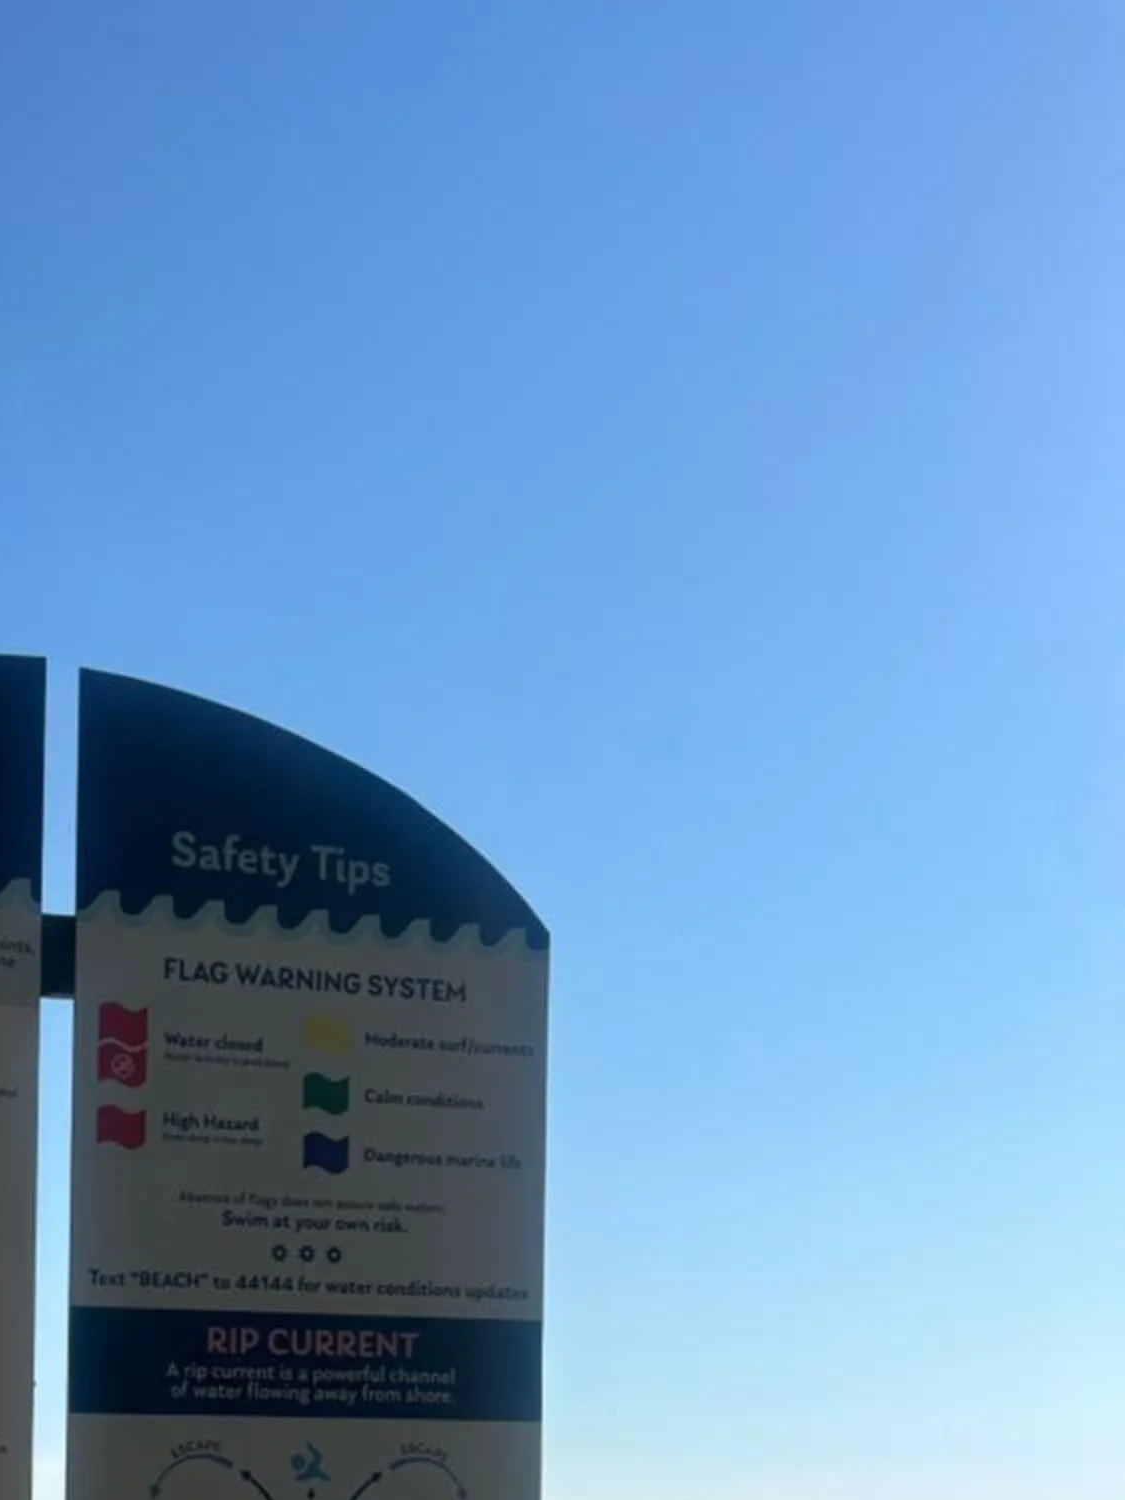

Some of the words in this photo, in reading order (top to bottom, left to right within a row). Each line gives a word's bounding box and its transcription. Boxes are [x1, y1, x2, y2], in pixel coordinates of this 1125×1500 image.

[171, 831, 300, 888] Safety
[310, 844, 391, 895] Tips
[163, 956, 228, 984] FLAG
[235, 962, 361, 995] WARNING
[368, 975, 467, 1002] SYSTEM
[164, 1032, 209, 1048] Water
[215, 1035, 263, 1052] closed
[365, 1032, 434, 1051] Moderate
[364, 1089, 403, 1105] Calm
[407, 1094, 484, 1109] conditions
[163, 1112, 200, 1131] High
[204, 1115, 259, 1131] Hazard
[364, 1148, 442, 1166] Dangerous
[446, 1156, 495, 1168] marine
[222, 1210, 268, 1227] Swim
[273, 1217, 290, 1229] at
[295, 1218, 332, 1233] your
[336, 1220, 369, 1231] own
[374, 1218, 408, 1233] risk.
[88, 1269, 125, 1286] Text
[131, 1272, 208, 1289] "BEACH"
[213, 1277, 231, 1289] to
[235, 1276, 294, 1291] 44144
[298, 1277, 322, 1292] for
[326, 1281, 372, 1294] water
[377, 1281, 461, 1298] conditions
[465, 1285, 530, 1302] updates
[207, 1327, 260, 1355] RIP
[268, 1328, 419, 1358] CURRENT
[166, 1363, 179, 1377] A
[185, 1363, 207, 1382] rip
[211, 1367, 275, 1380] current
[279, 1364, 293, 1380] is
[298, 1369, 309, 1380] a
[312, 1365, 385, 1385] powerful
[389, 1367, 456, 1384] channel
[171, 1380, 188, 1398] of
[192, 1385, 243, 1398] water
[247, 1382, 312, 1406] flowing
[314, 1387, 357, 1406] away
[362, 1385, 401, 1402] from
